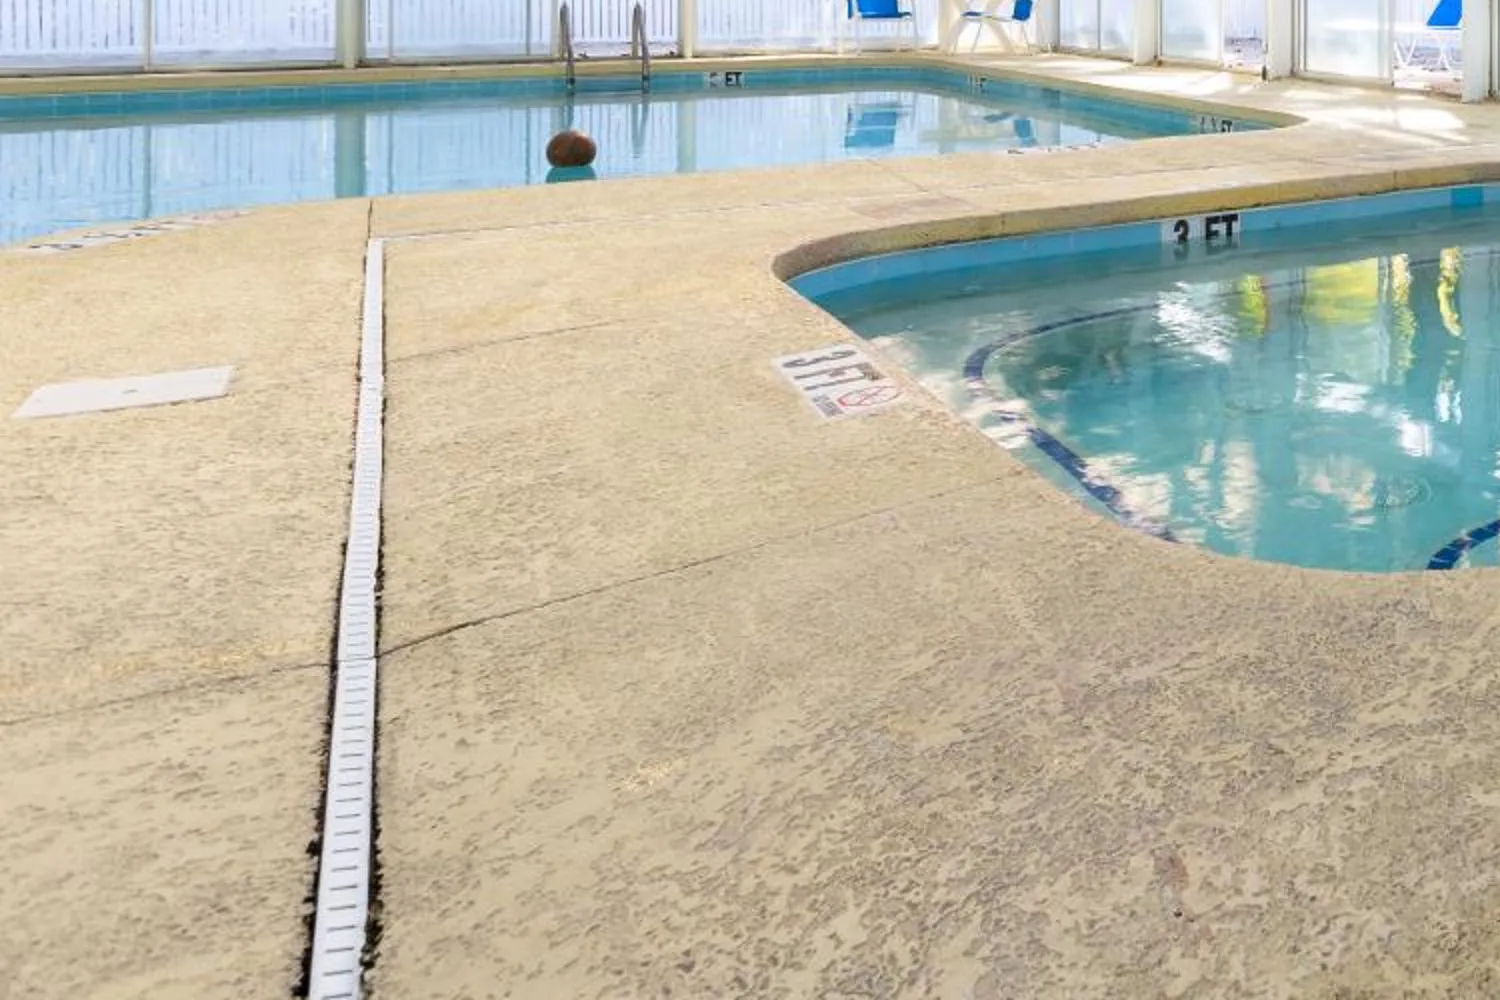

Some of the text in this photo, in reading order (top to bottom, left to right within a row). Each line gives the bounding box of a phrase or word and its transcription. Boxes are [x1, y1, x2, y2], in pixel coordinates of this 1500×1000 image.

[1205, 213, 1239, 243] FT
[782, 349, 885, 392] 3 FT
